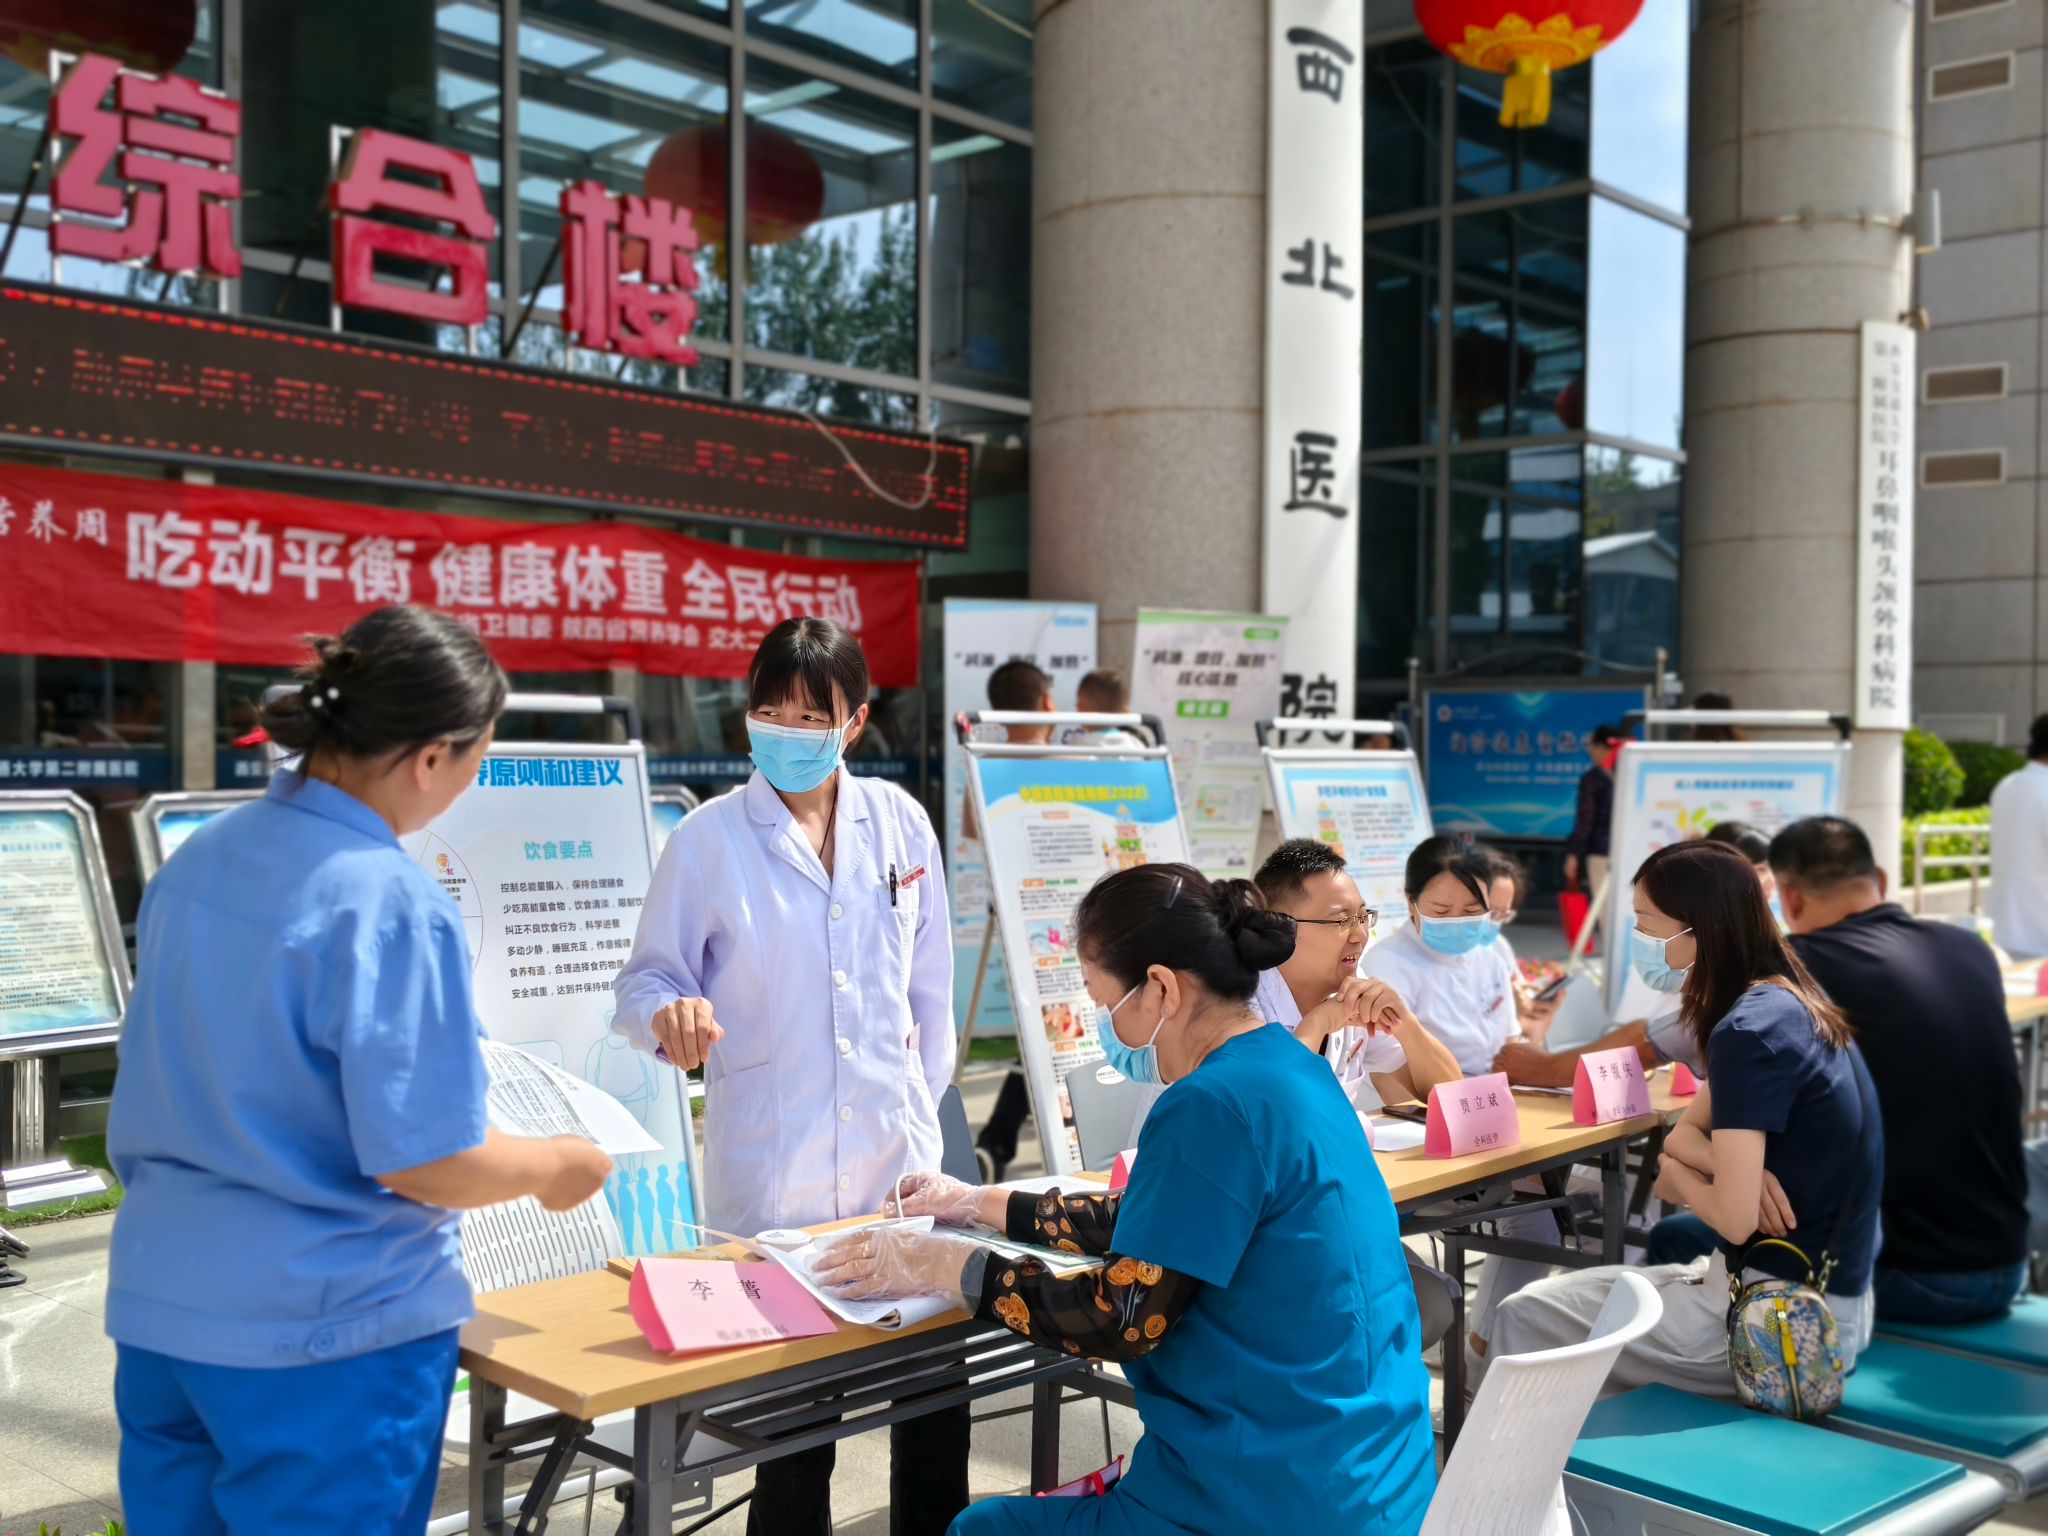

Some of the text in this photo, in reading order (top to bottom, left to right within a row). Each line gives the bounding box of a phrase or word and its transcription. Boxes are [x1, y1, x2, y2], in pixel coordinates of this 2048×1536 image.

[51, 52, 700, 367] 综合楼
[1280, 26, 1356, 748] 西北医院
[126, 511, 416, 603] 吃动平衡
[429, 541, 669, 615] 健康体重
[680, 558, 863, 632] 全民行动
[524, 840, 594, 861] 饮食要点
[500, 878, 625, 894] 控制总能量摄入，保持合理膳食
[504, 919, 621, 936] 纠正不良饮食行为，科学进餐
[506, 939, 632, 957] 多动少静，睡眠充足，作息规律
